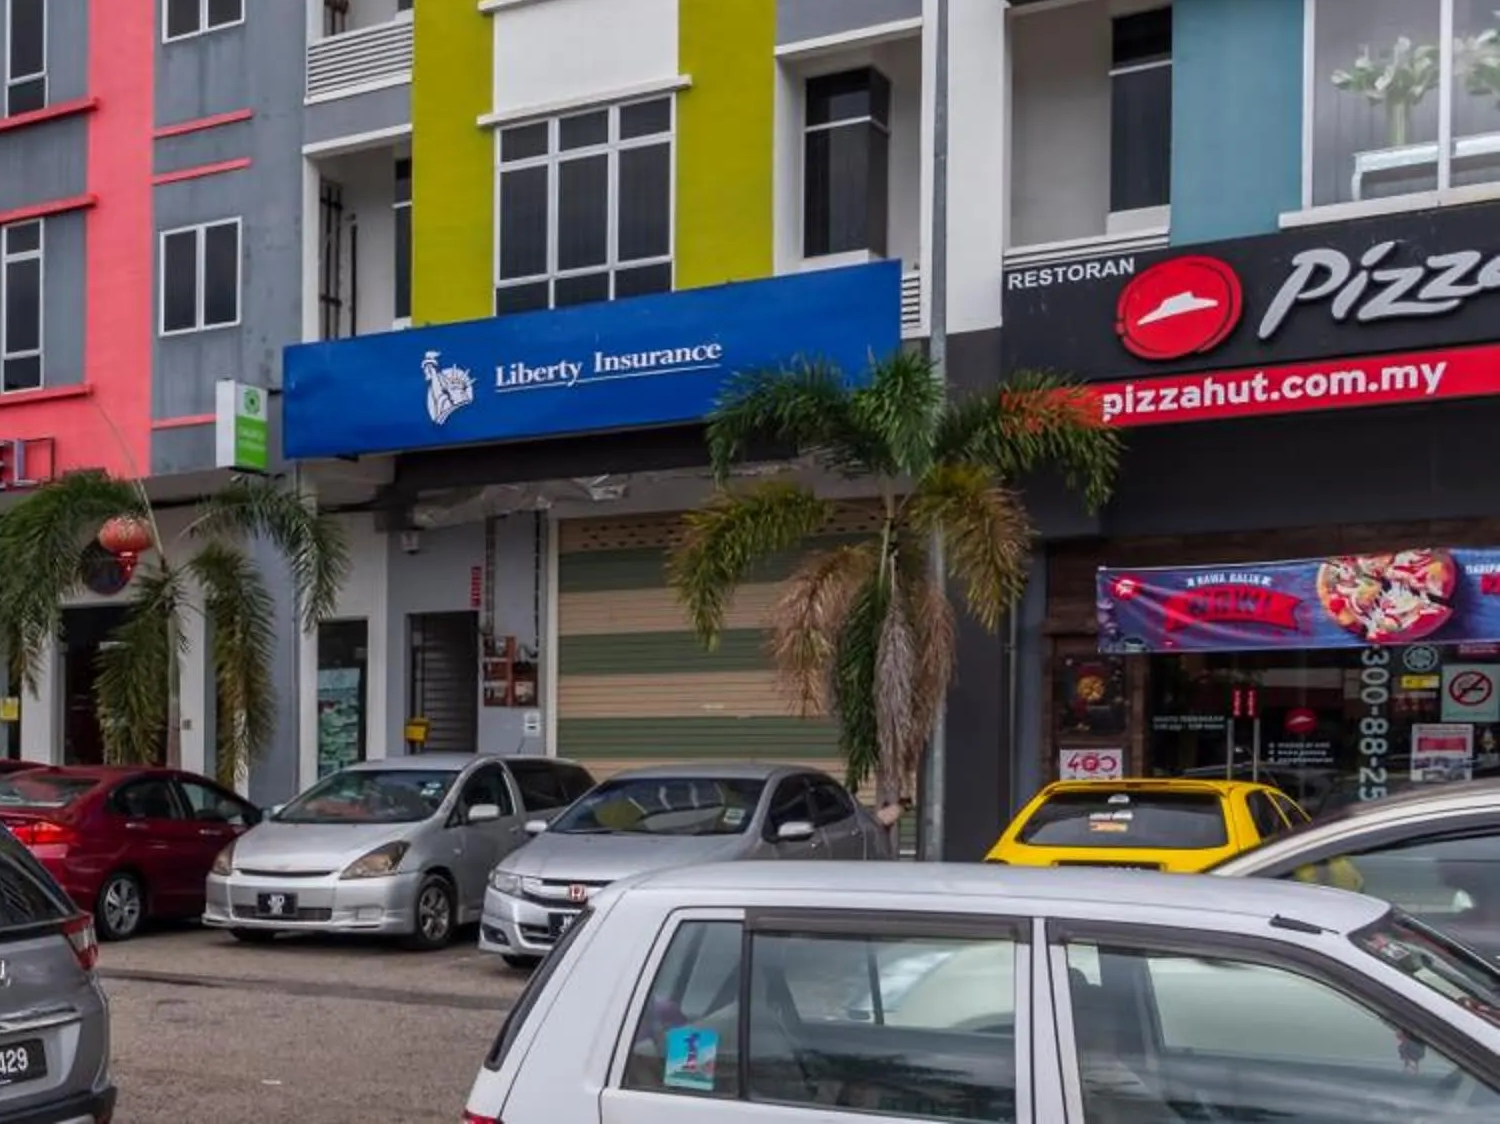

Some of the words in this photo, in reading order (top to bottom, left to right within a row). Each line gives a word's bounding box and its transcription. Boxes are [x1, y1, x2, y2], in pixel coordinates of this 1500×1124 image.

[1007, 257, 1135, 290] RESTORAN
[495, 360, 583, 387] Liberty
[594, 342, 722, 373] Insurance
[1102, 361, 1448, 422] pizzahut.com.my
